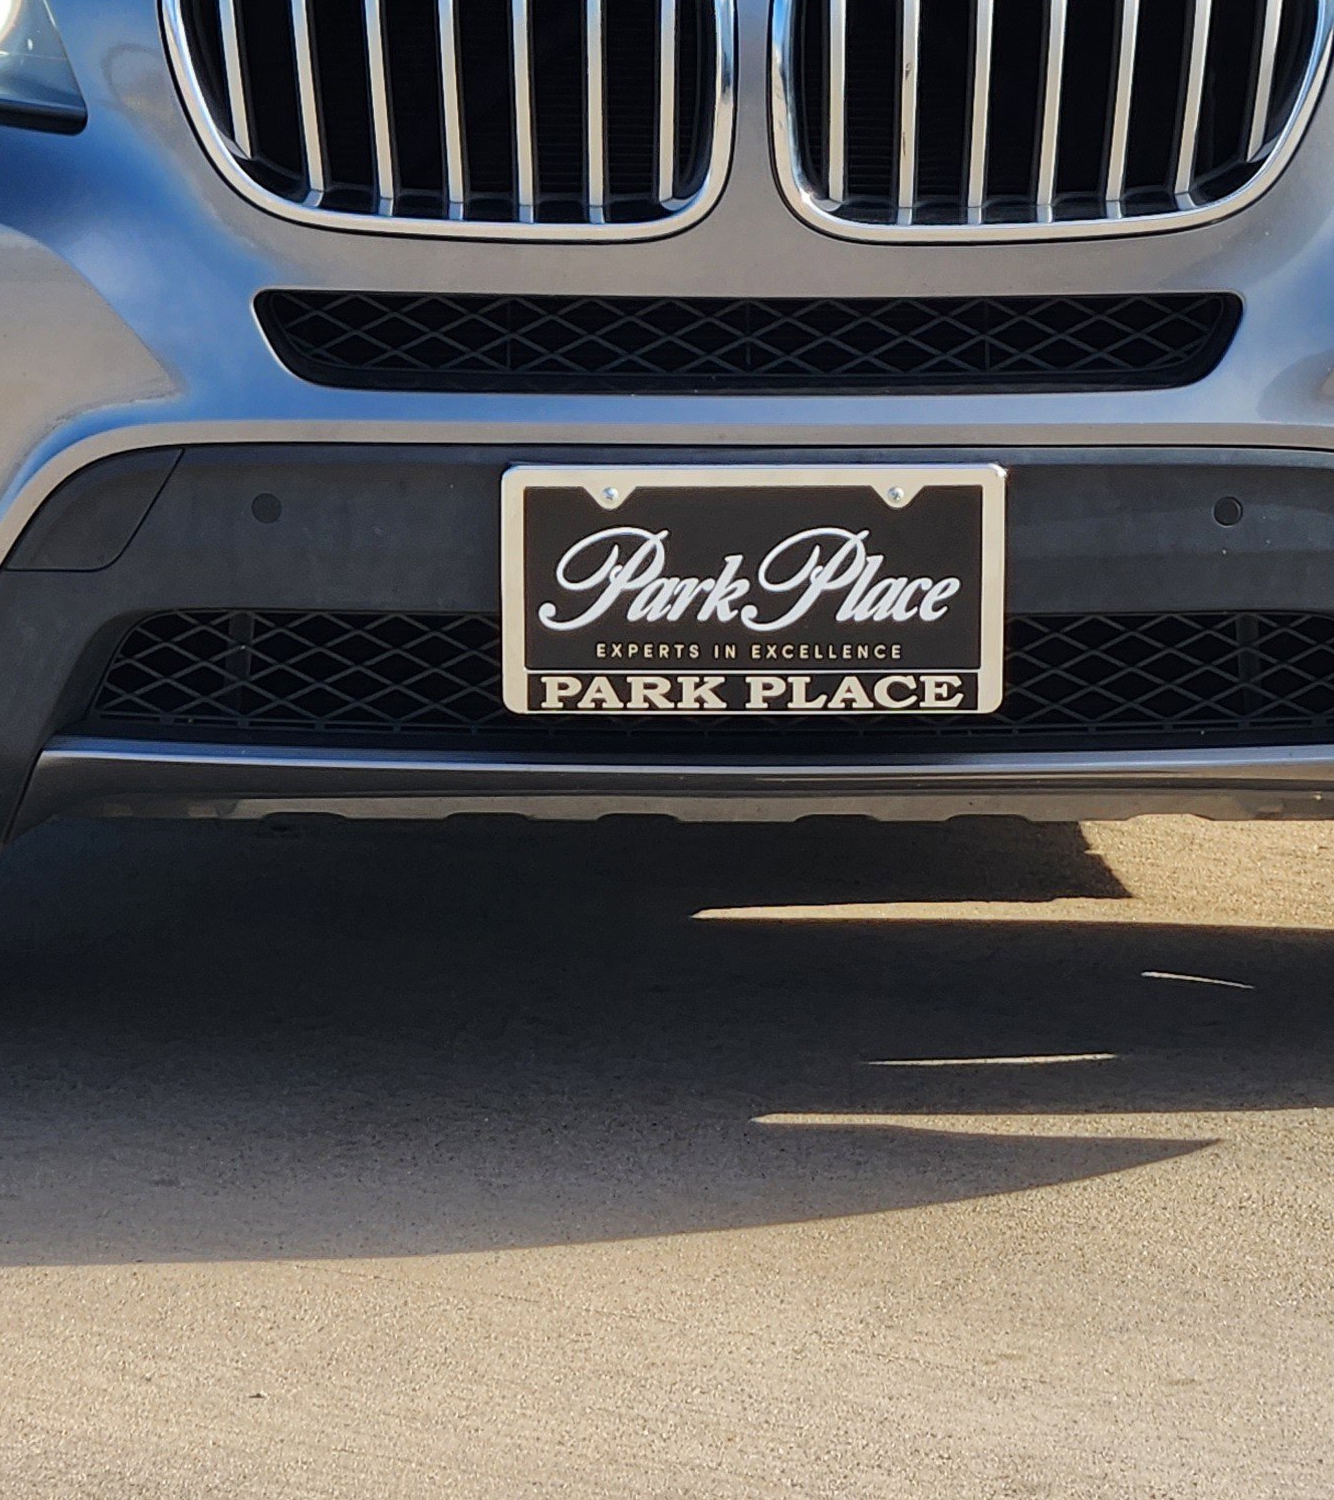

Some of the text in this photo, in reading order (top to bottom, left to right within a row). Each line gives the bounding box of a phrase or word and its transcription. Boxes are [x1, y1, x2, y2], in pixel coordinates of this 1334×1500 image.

[538, 526, 961, 632] Park Place
[596, 643, 902, 659] EXPERTS IN EXCELLENCE
[540, 675, 965, 709] PARK PLACE
